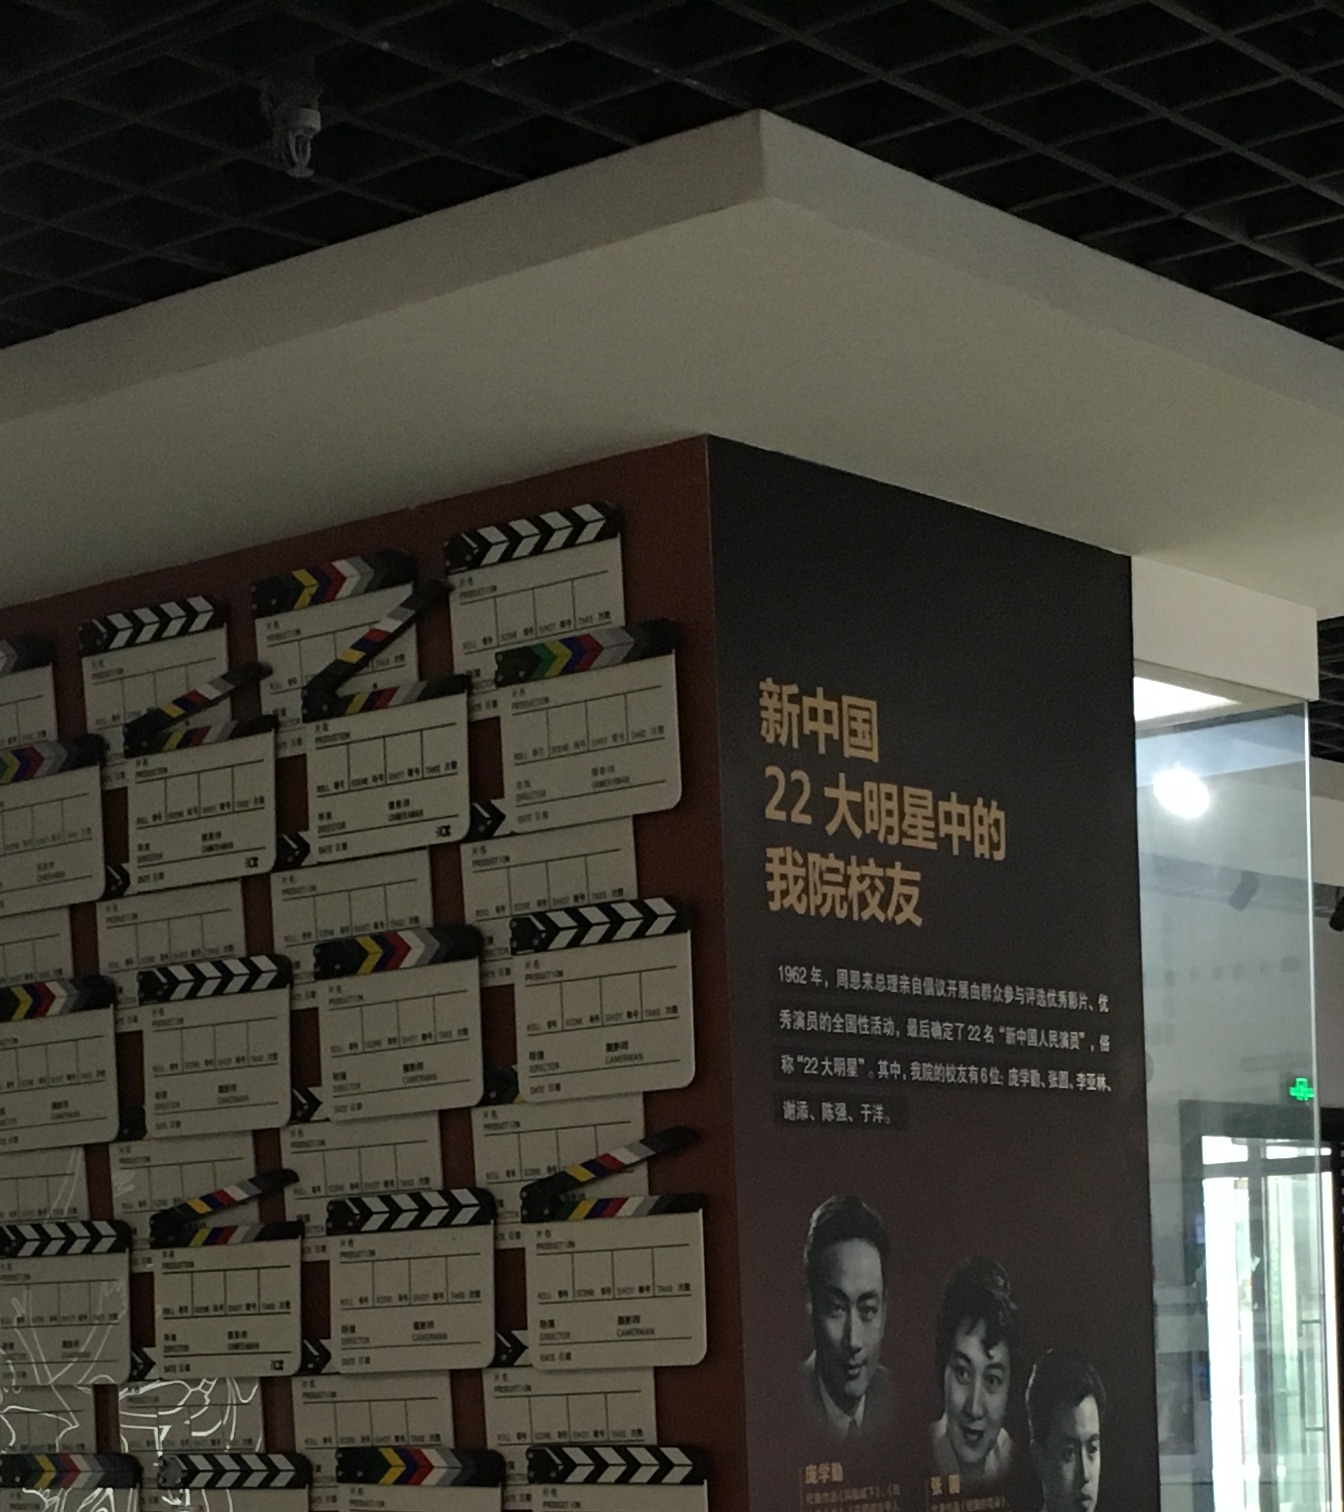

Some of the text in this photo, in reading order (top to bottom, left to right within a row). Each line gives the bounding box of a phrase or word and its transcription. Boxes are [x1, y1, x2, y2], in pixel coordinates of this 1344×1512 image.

[759, 677, 879, 762] 新中国
[766, 846, 923, 927] 我院校友
